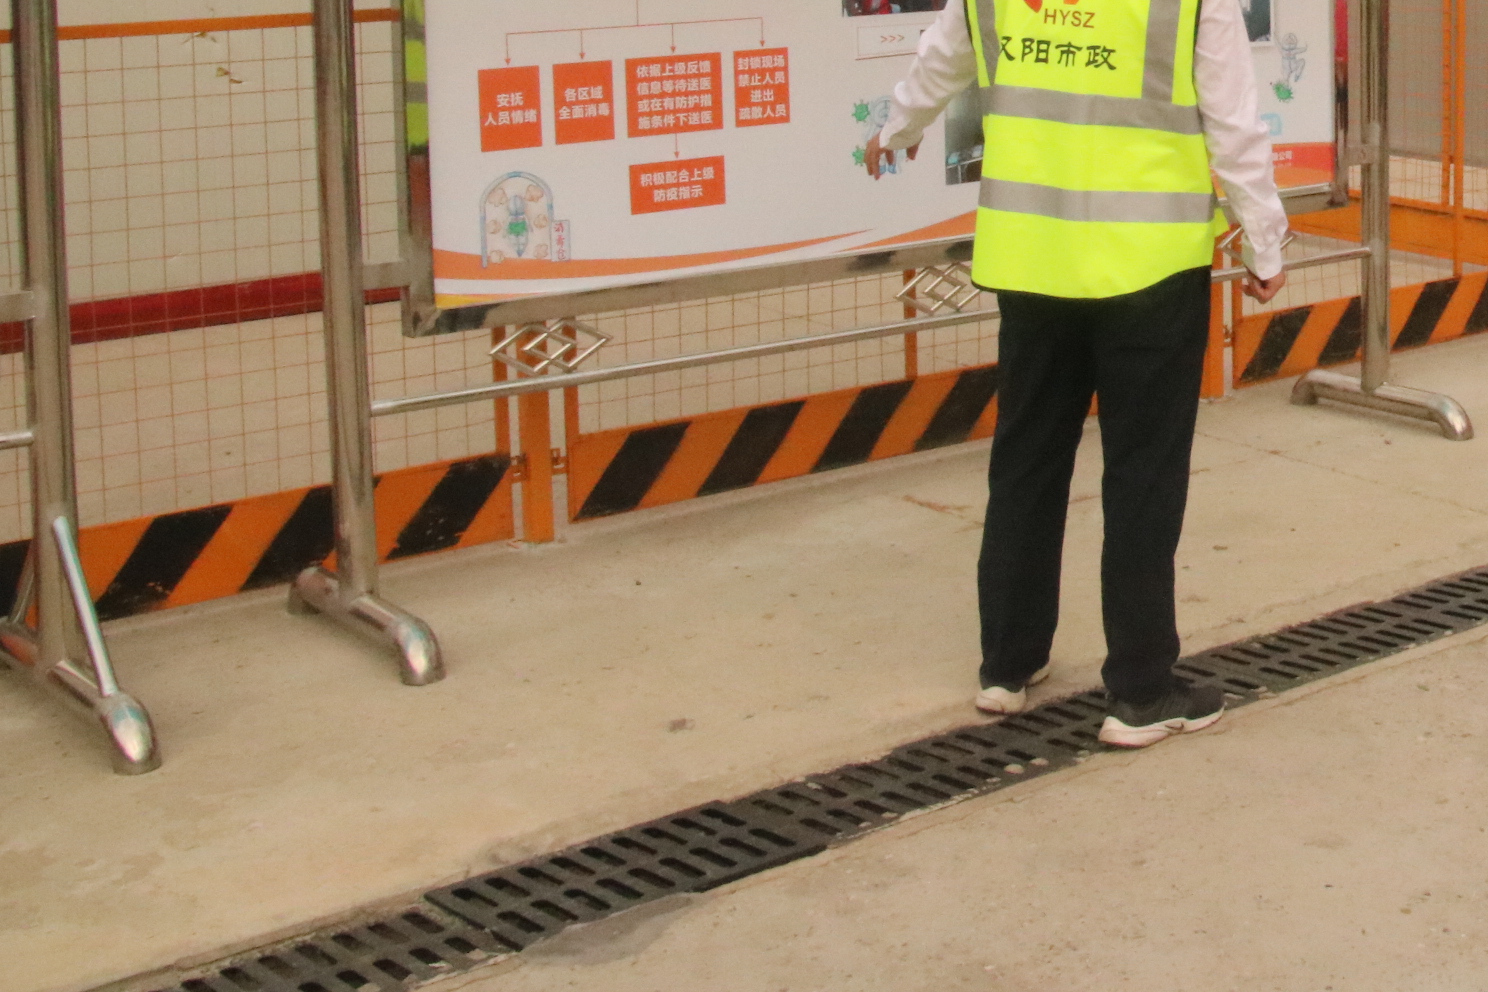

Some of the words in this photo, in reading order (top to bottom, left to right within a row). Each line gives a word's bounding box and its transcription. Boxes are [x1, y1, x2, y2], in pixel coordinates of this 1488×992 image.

[1043, 8, 1096, 29] HYSZ
[636, 60, 711, 79] 依据上级反馈
[737, 55, 785, 71] 封锁现场
[636, 77, 712, 95] 信息等待送医
[737, 71, 786, 87] 禁止人员
[496, 92, 524, 108] 安抚
[564, 86, 604, 103] 各区域
[637, 94, 712, 113] 或在有防护措
[750, 89, 774, 103] 进出
[484, 109, 537, 127] 人员情绪
[558, 102, 610, 120] 全面消毒
[637, 110, 713, 130] 施条件下送医
[738, 104, 787, 120] 疏散人员
[640, 166, 715, 187] 积极配合上级
[653, 185, 704, 203] 防疫指示
